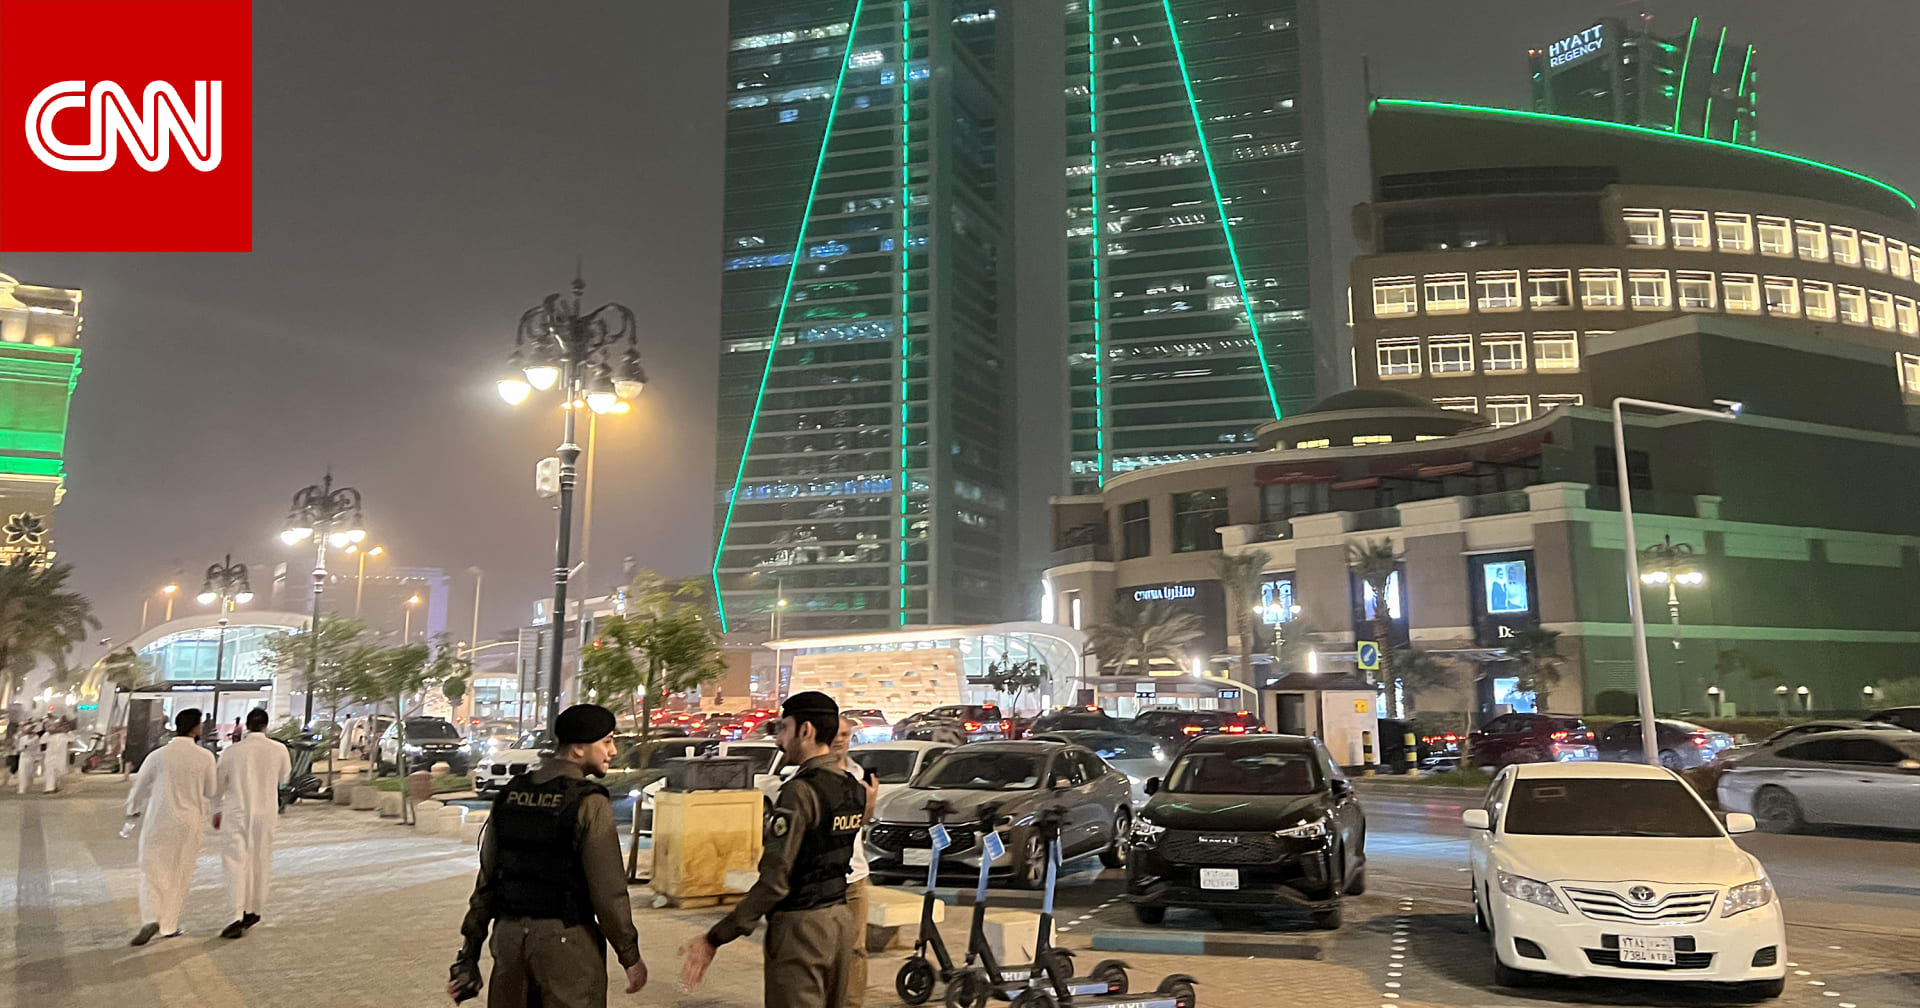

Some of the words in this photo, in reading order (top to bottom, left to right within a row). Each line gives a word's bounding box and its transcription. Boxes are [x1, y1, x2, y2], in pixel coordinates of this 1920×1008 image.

[1549, 24, 1603, 57] HYATT
[1550, 37, 1603, 67] REGENCY
[506, 791, 564, 808] POLICE
[832, 813, 863, 831] POLICE
